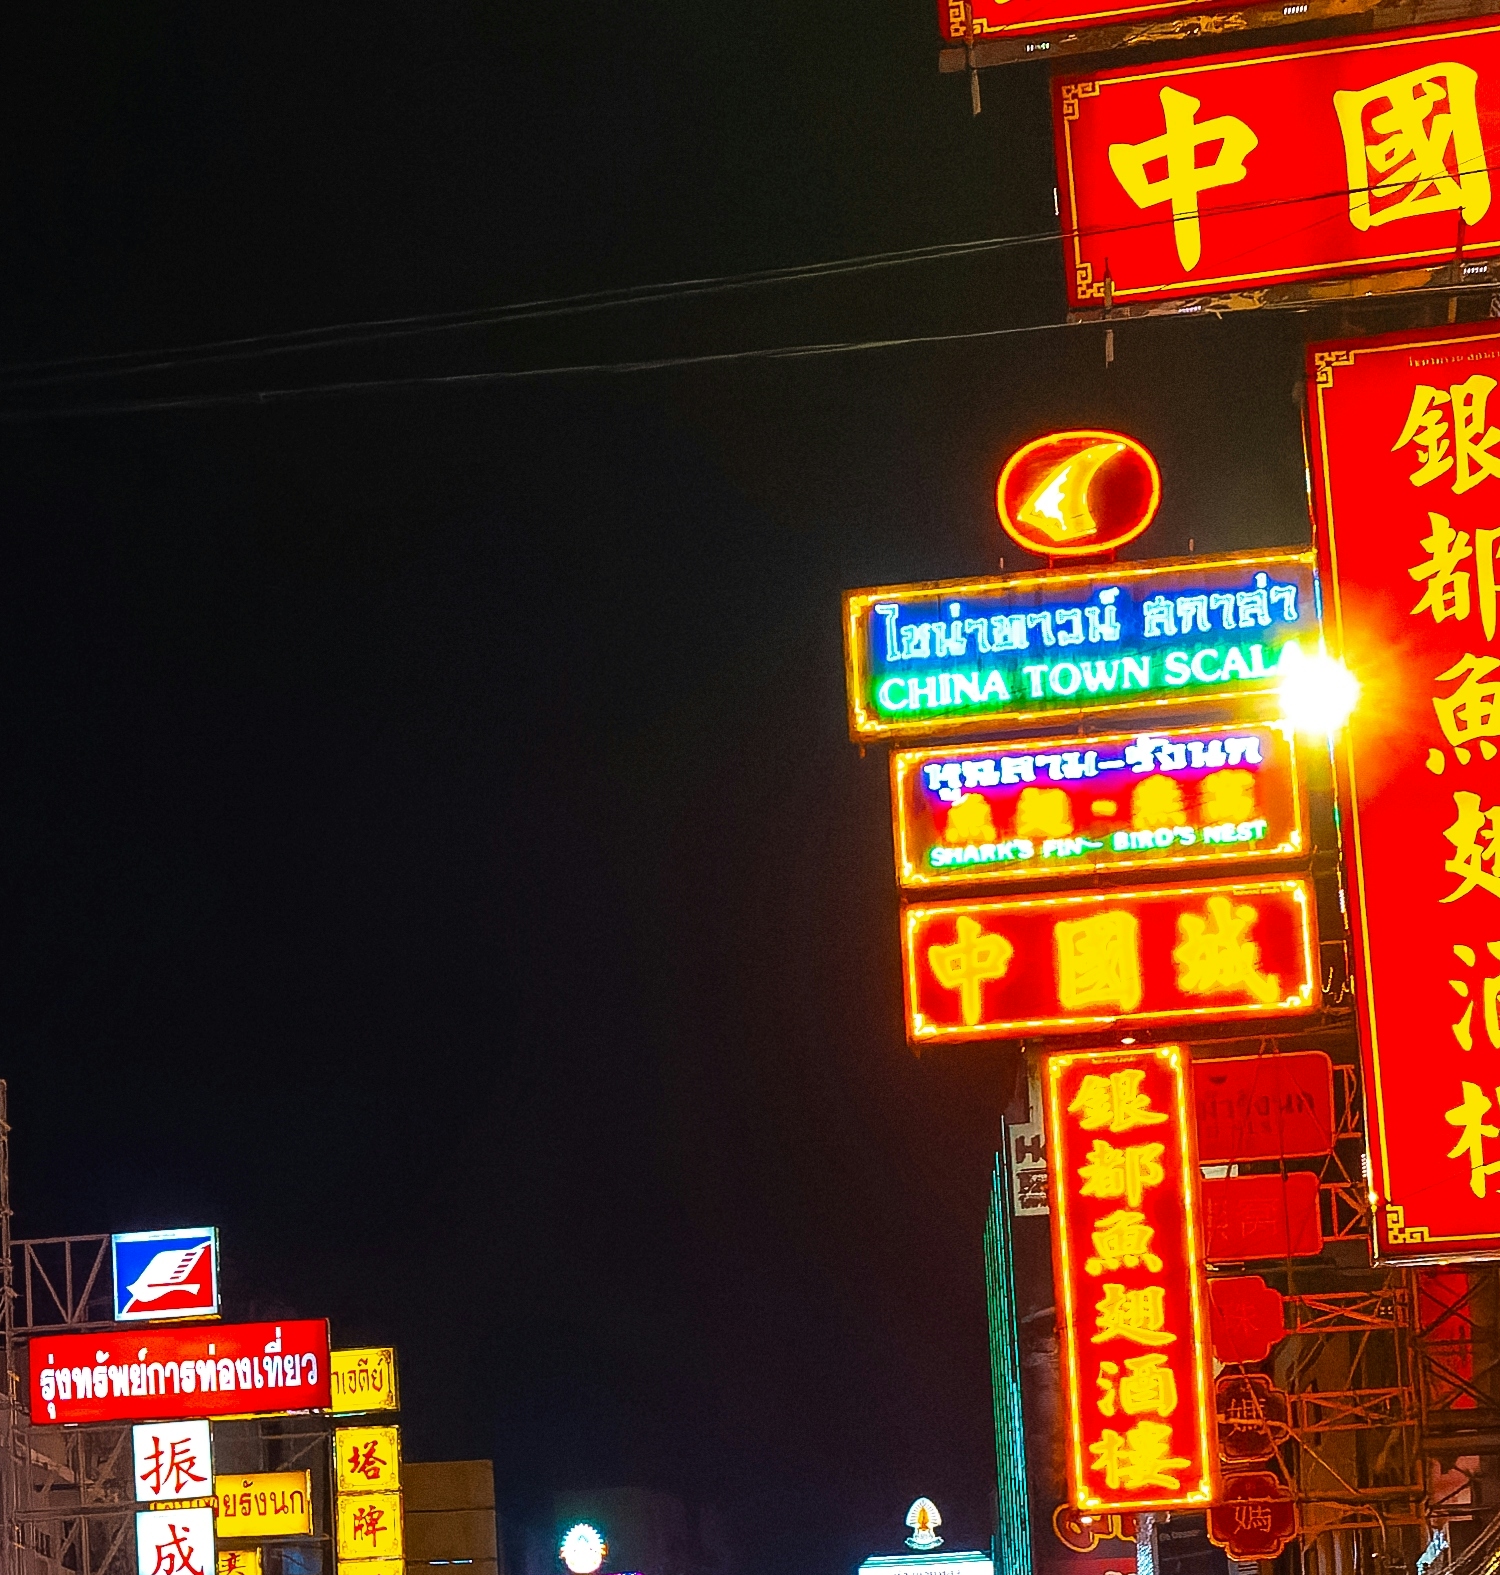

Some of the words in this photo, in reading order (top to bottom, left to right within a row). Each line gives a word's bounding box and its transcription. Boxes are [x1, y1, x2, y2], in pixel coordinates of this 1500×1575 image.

[878, 668, 1009, 710] CHINA
[1023, 657, 1151, 700] TOWN
[1203, 820, 1268, 843] NEST
[928, 898, 1280, 1026] 中國城
[1067, 1068, 1191, 1491] 銀都魚翅酒樓
[40, 1327, 318, 1420] รุ่งทรัพย์การท่องเที่ยว
